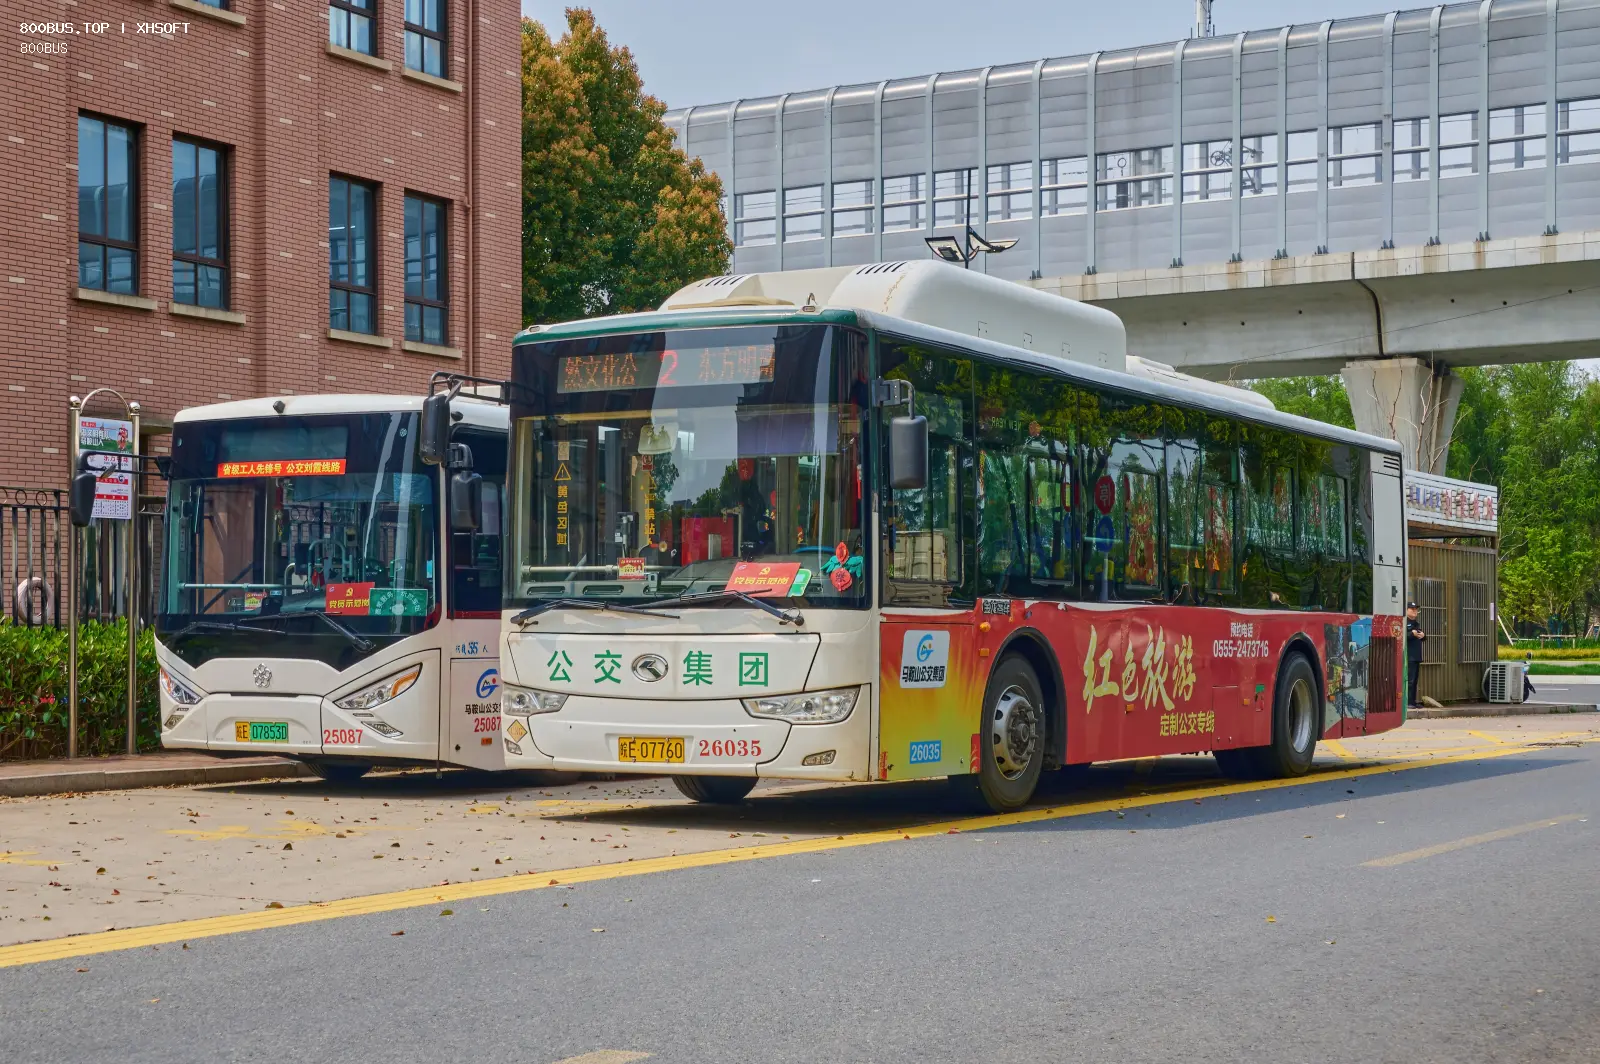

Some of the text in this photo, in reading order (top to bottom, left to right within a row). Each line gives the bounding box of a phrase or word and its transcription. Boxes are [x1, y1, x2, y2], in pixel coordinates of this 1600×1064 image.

[659, 350, 679, 385] 2
[223, 461, 341, 476] 省级工人先锋号 公交刘霞线路
[734, 577, 789, 586] 党员示范岗
[329, 598, 370, 609] 党员示范岗
[1230, 622, 1254, 638] 预约电话
[1213, 640, 1269, 658] 0555-2473716
[547, 650, 769, 687] 公交集团
[902, 665, 946, 682] 马鞍山公交集团
[1083, 624, 1197, 714] 红色旅游
[465, 703, 501, 715] 马鞍山公交
[474, 716, 501, 733] 25087
[1159, 711, 1215, 737] 定制公交专线
[323, 729, 364, 744] 25087
[699, 740, 762, 757] 26035
[911, 743, 941, 761] 26035
